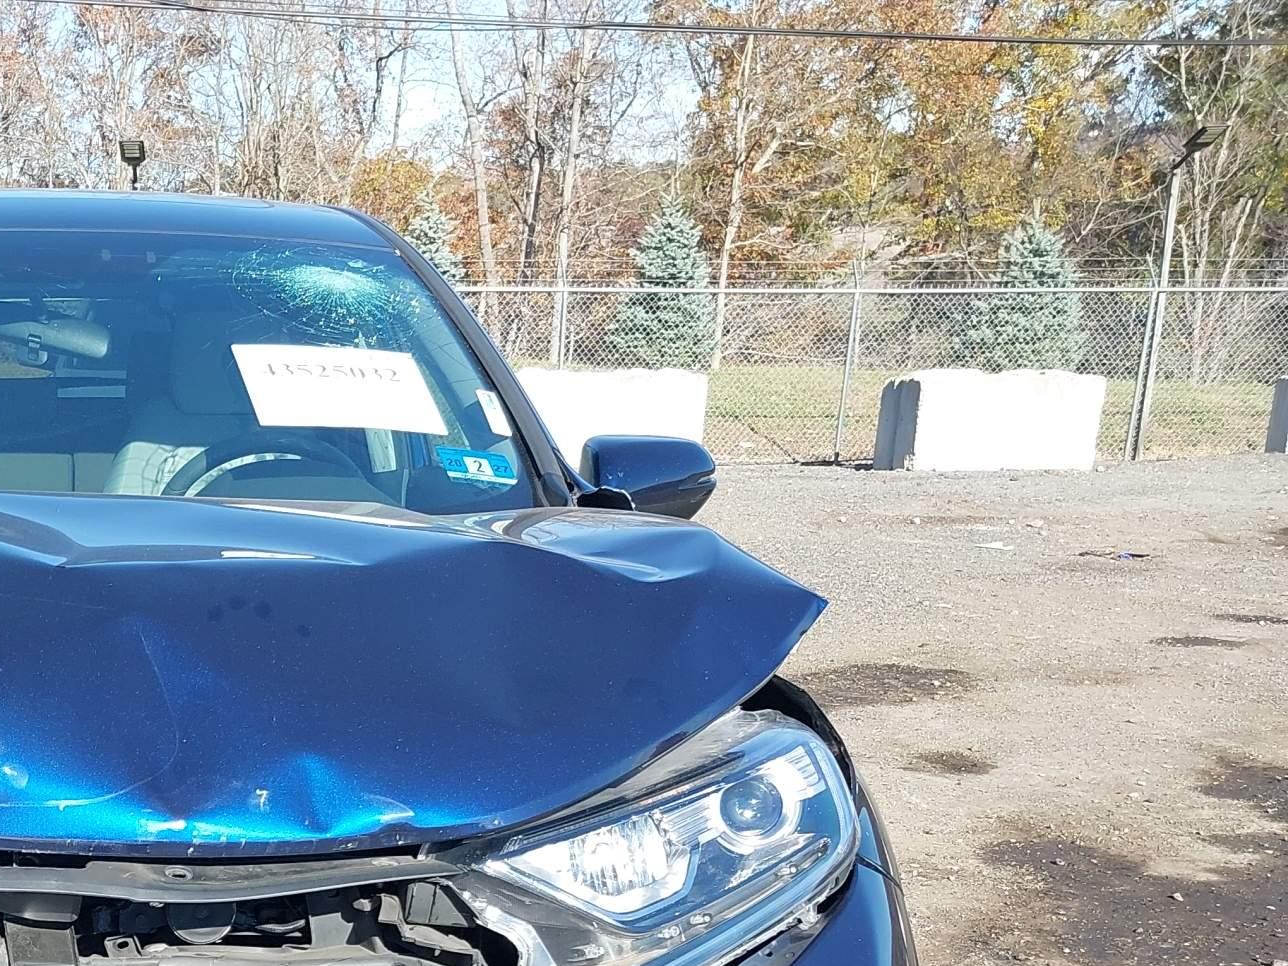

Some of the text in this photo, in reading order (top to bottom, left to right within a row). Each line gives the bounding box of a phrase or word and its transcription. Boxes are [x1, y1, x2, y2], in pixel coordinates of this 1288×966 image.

[446, 458, 509, 474] 20 2 27
